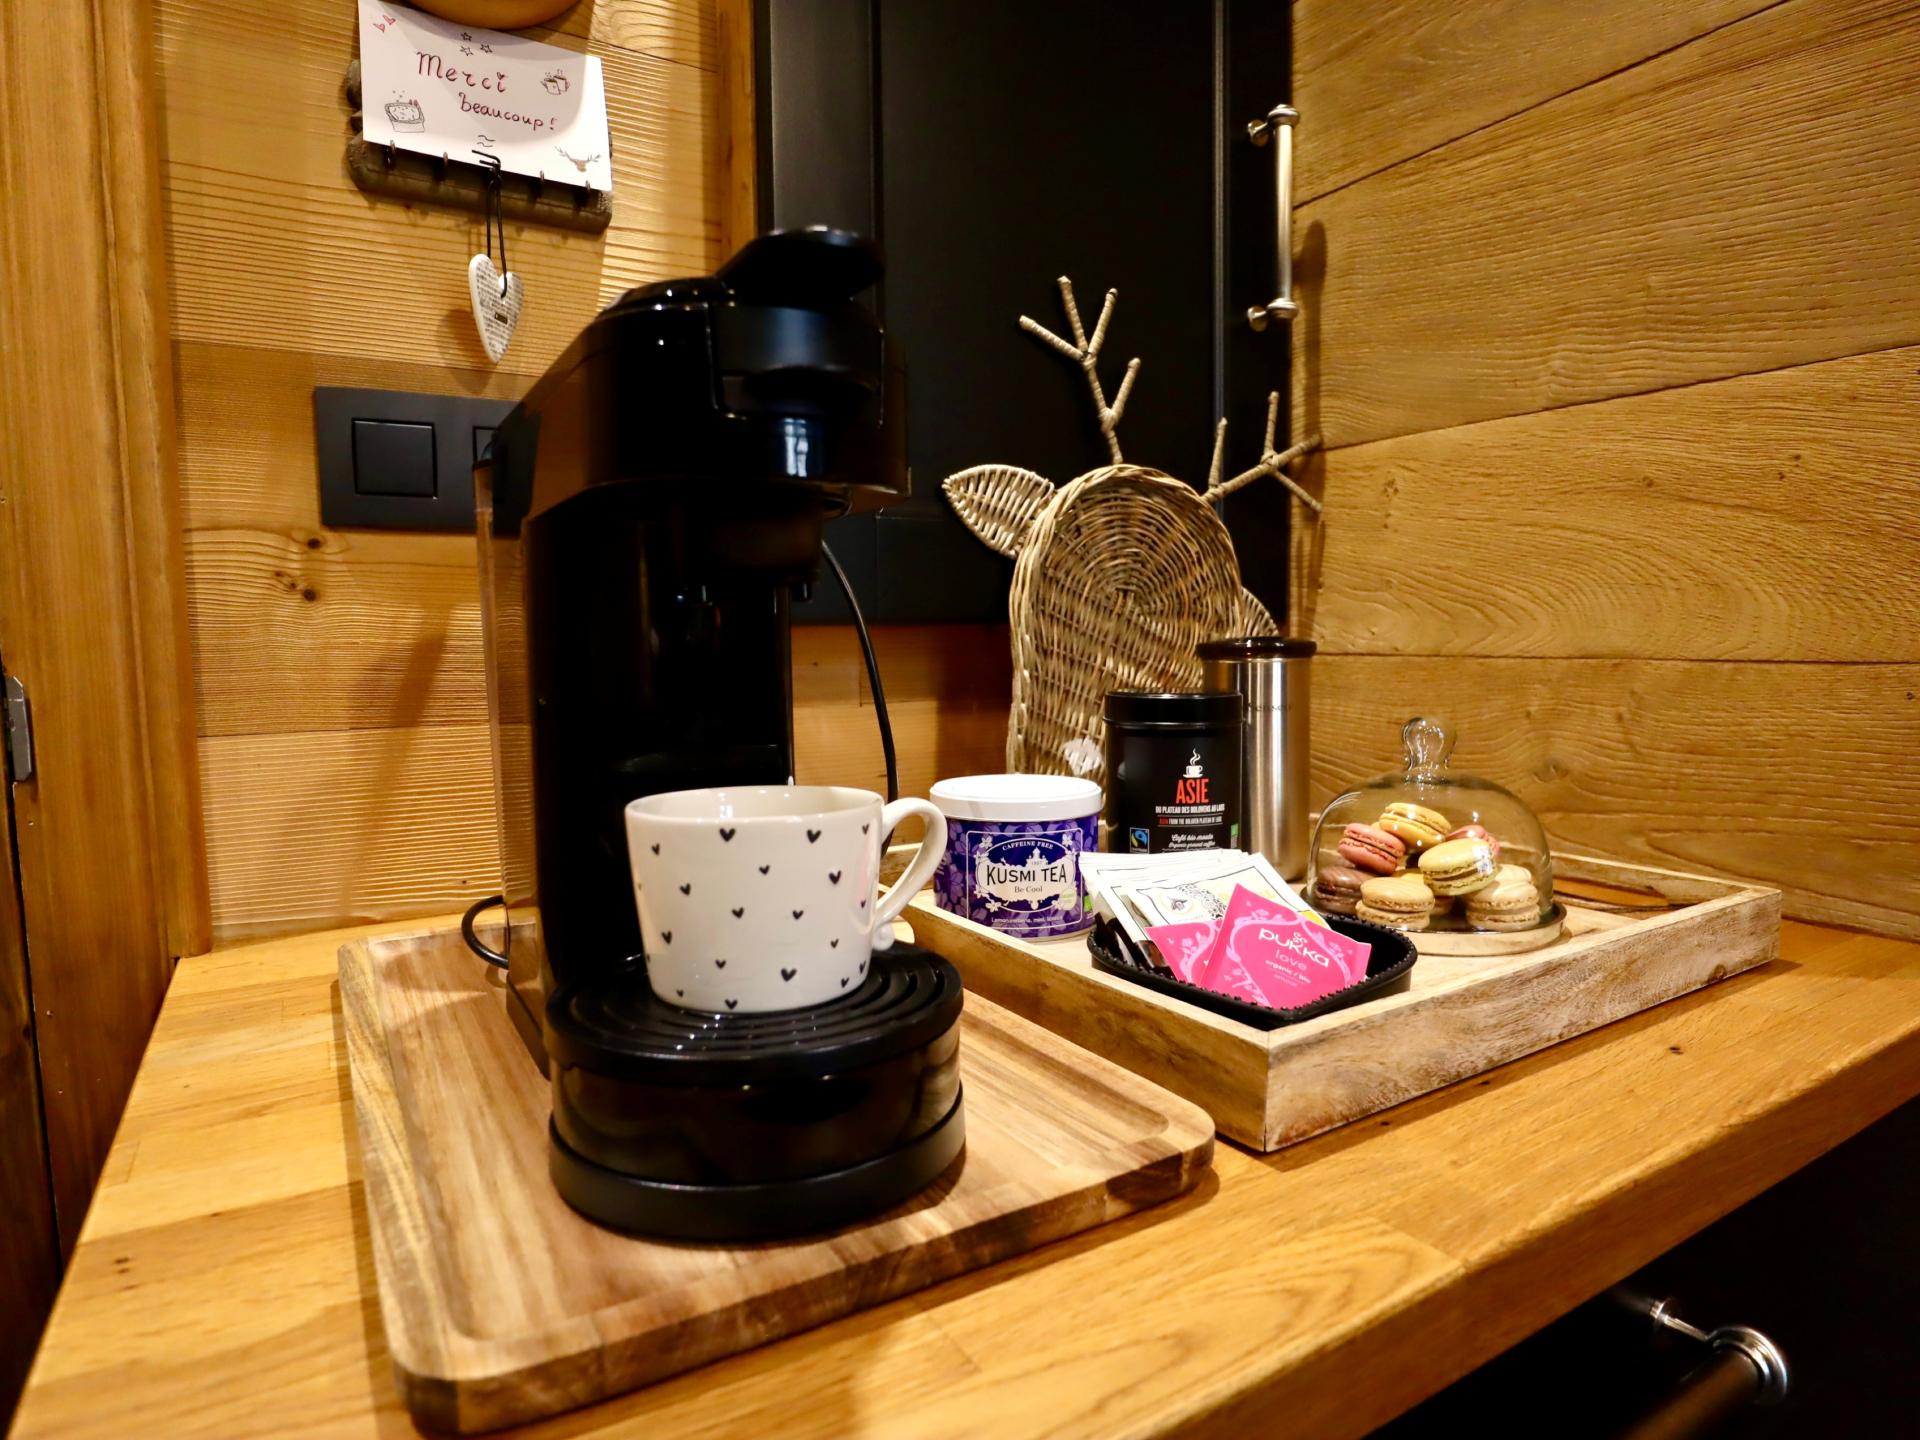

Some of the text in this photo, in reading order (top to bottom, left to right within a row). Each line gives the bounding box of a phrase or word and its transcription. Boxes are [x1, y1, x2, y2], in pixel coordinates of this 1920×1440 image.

[417, 51, 507, 93] Merci
[1176, 778, 1209, 804] ASIE
[1162, 805, 1181, 814] PLATEAU
[1181, 806, 1190, 814] DES
[1002, 841, 1054, 851] CAFFEINE FREE
[986, 863, 1067, 886] KUSMI TEA
[1026, 885, 1043, 893] Cool
[1275, 949, 1307, 971] love
